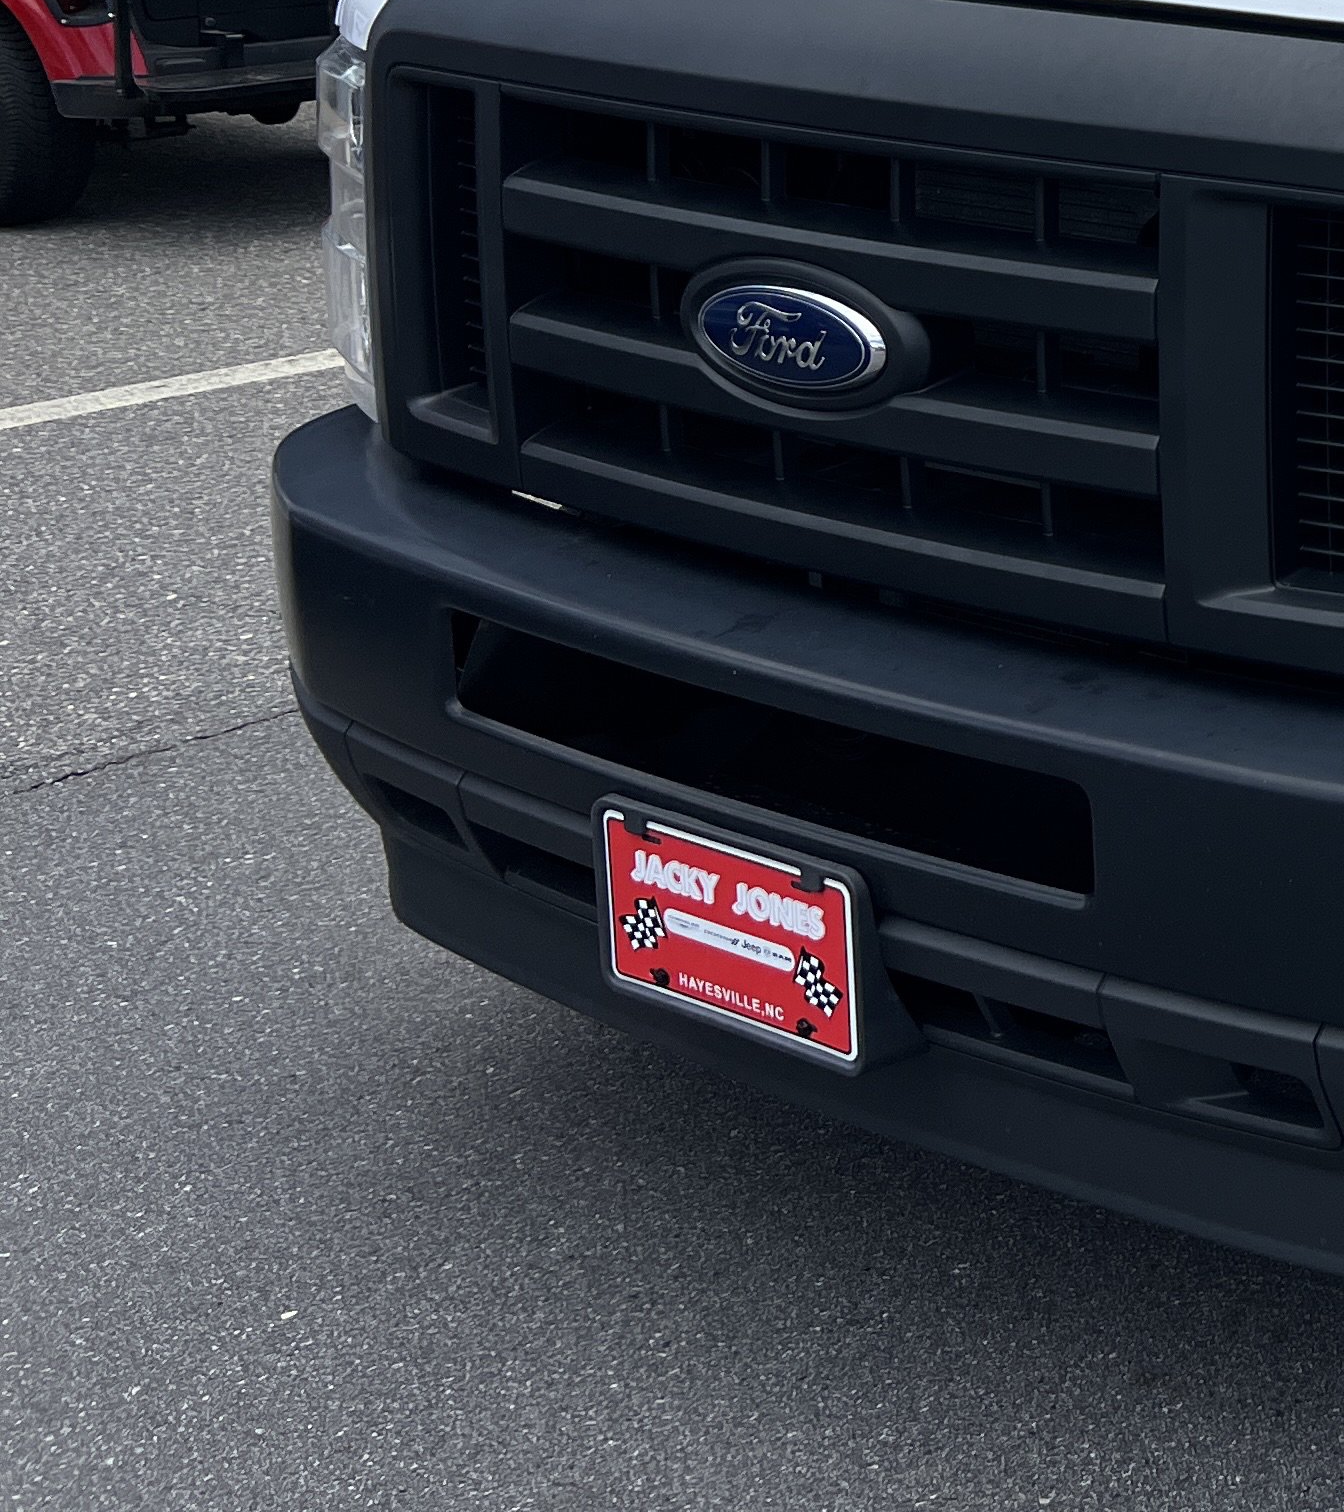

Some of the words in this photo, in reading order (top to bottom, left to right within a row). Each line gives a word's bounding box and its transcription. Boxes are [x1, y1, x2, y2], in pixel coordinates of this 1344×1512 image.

[730, 300, 827, 371] Ford
[630, 850, 720, 904] JACKY
[732, 883, 826, 941] JONES
